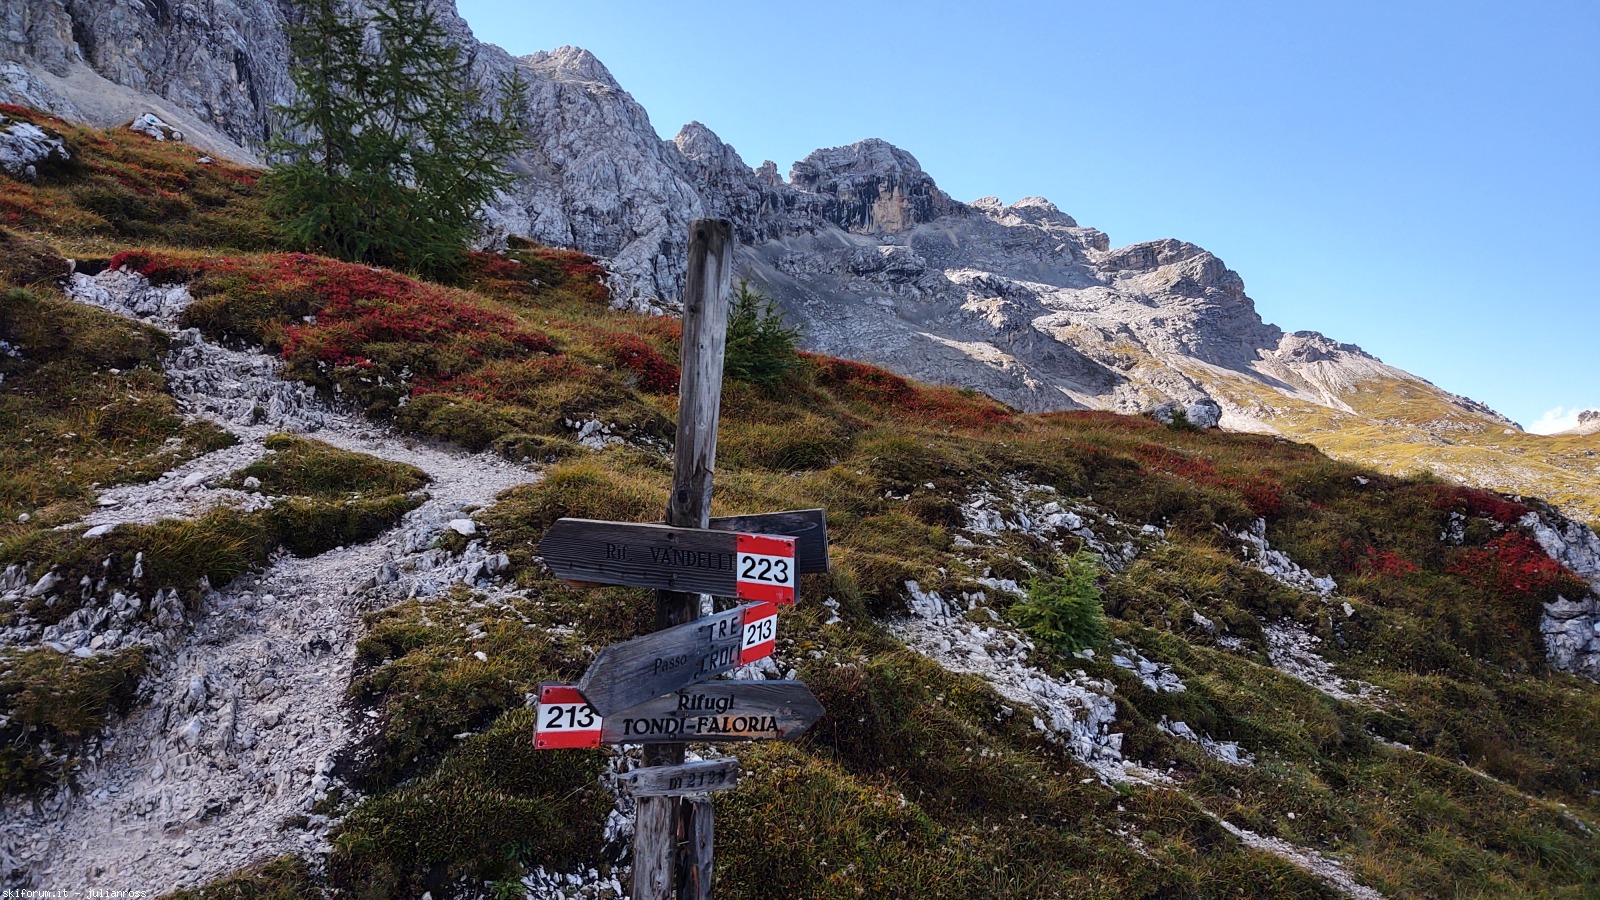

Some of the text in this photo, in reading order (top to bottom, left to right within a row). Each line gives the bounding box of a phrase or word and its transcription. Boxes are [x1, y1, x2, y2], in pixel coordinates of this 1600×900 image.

[651, 547, 734, 570] VANDELLI
[741, 556, 789, 583] 223
[708, 616, 738, 642] TRE
[746, 619, 772, 645] 213
[654, 654, 687, 675] Passo
[677, 694, 734, 714] Rifugi
[546, 705, 594, 728] 213
[669, 777, 682, 790] m
